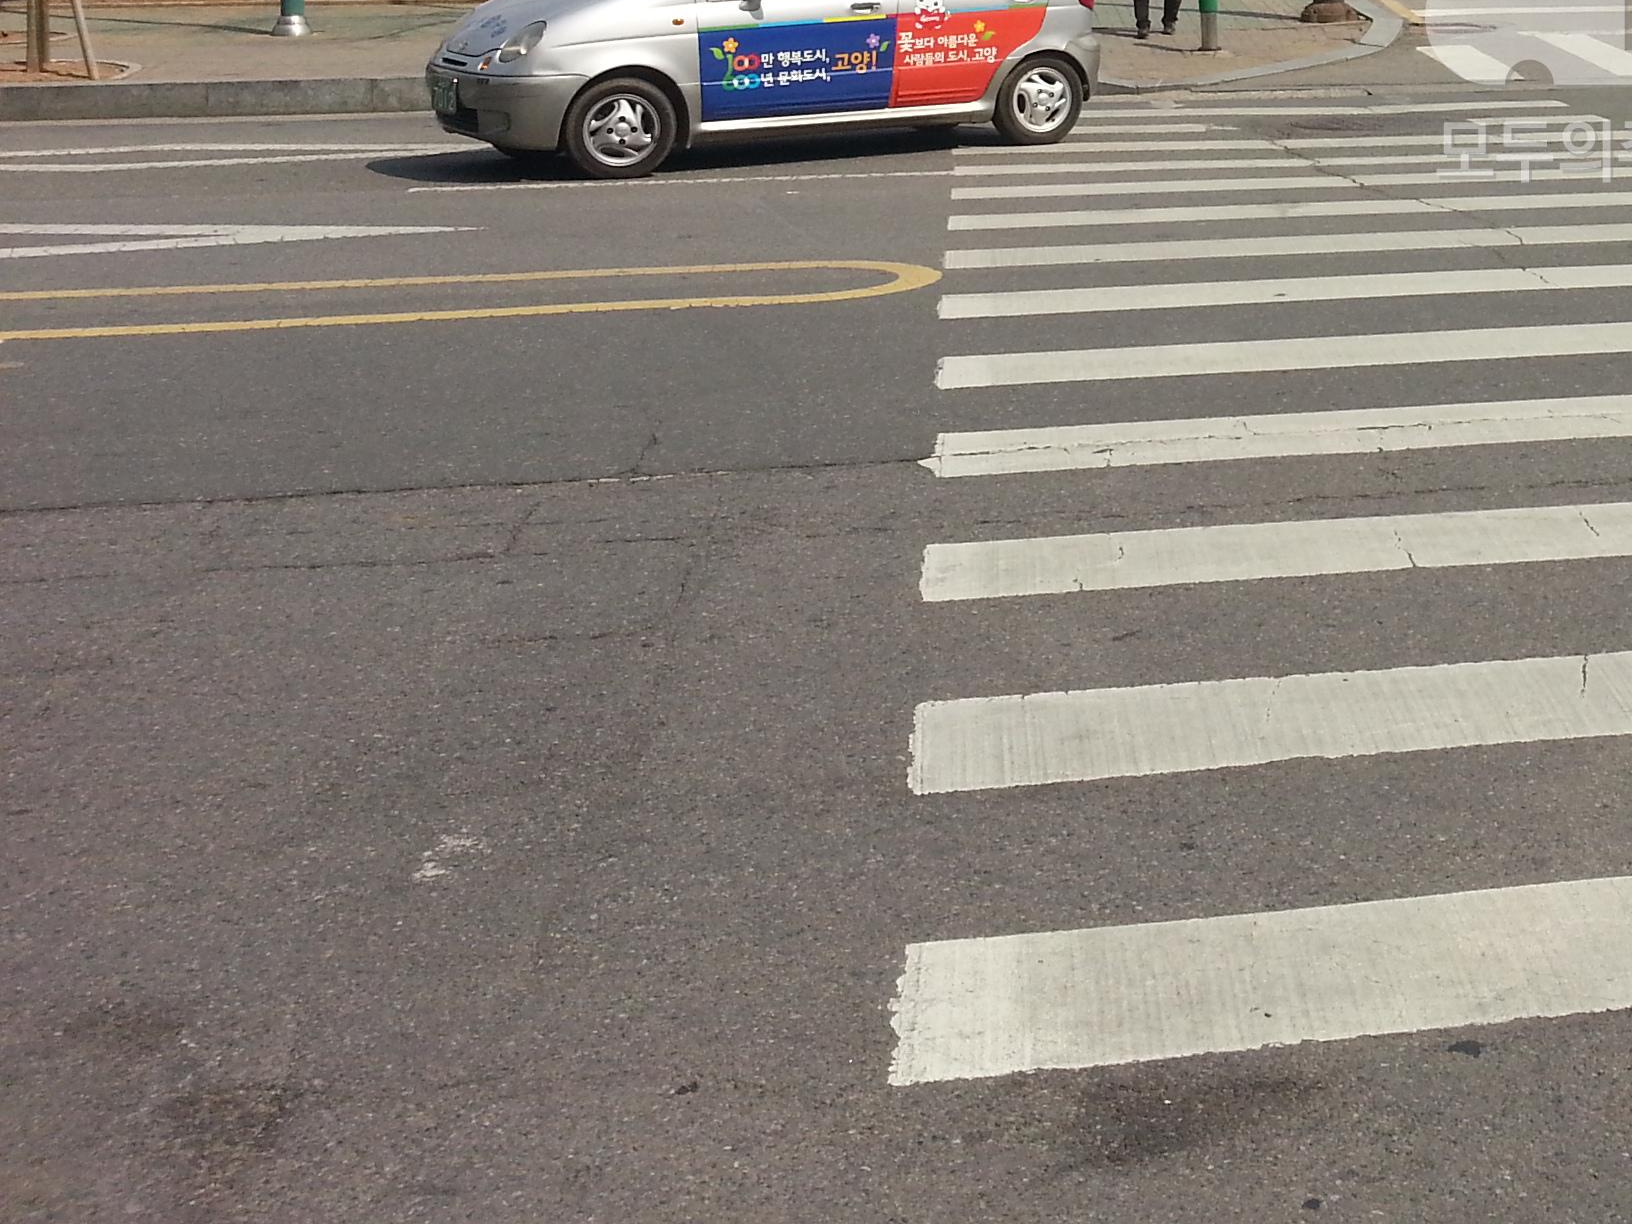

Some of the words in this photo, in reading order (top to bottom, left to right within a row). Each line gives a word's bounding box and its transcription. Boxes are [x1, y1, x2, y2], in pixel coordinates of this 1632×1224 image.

[897, 31, 934, 52] 꽃보다
[937, 33, 978, 49] 아름다운
[776, 48, 830, 68] 행복도시,
[831, 49, 878, 74] 고양!
[903, 51, 945, 67] 사람들의
[946, 49, 970, 63] 도시,
[971, 46, 998, 64] 고양
[776, 67, 831, 87] 문화도시,
